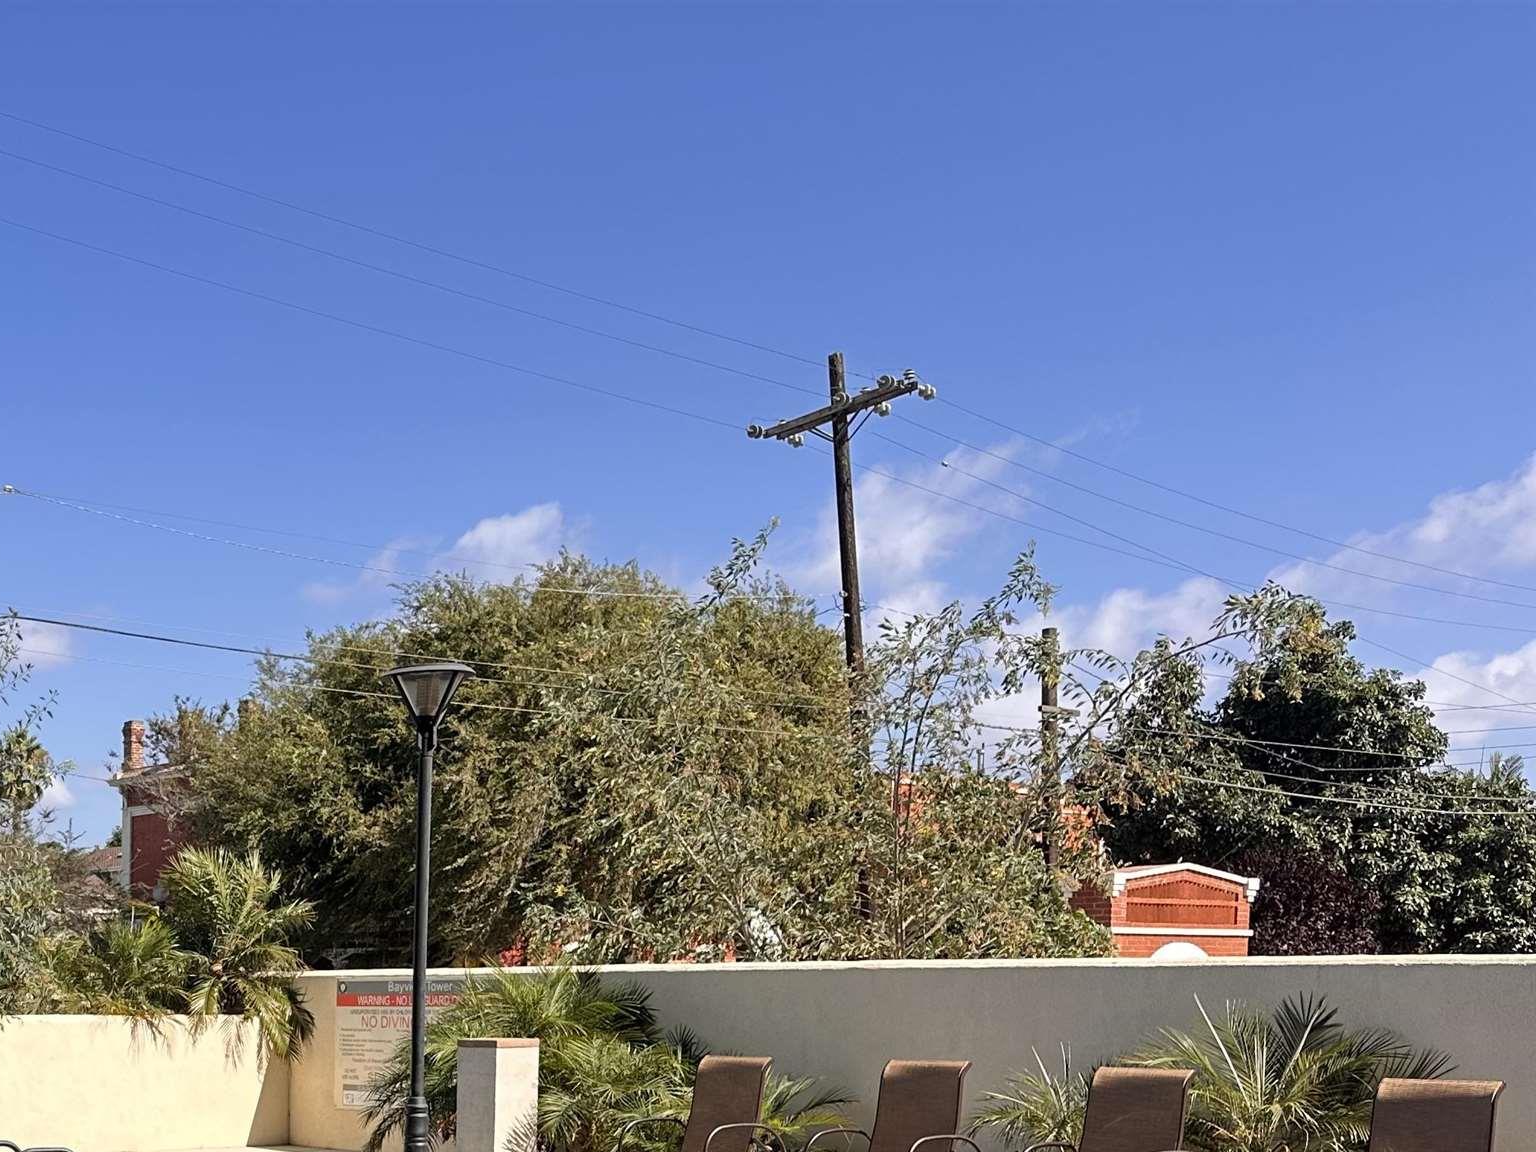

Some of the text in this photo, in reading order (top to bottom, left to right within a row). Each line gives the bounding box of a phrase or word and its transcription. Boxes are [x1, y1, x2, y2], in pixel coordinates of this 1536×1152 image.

[357, 995, 390, 1006] WARNING
[396, 995, 407, 1006] NO
[361, 1015, 411, 1029] NO DIVIN
